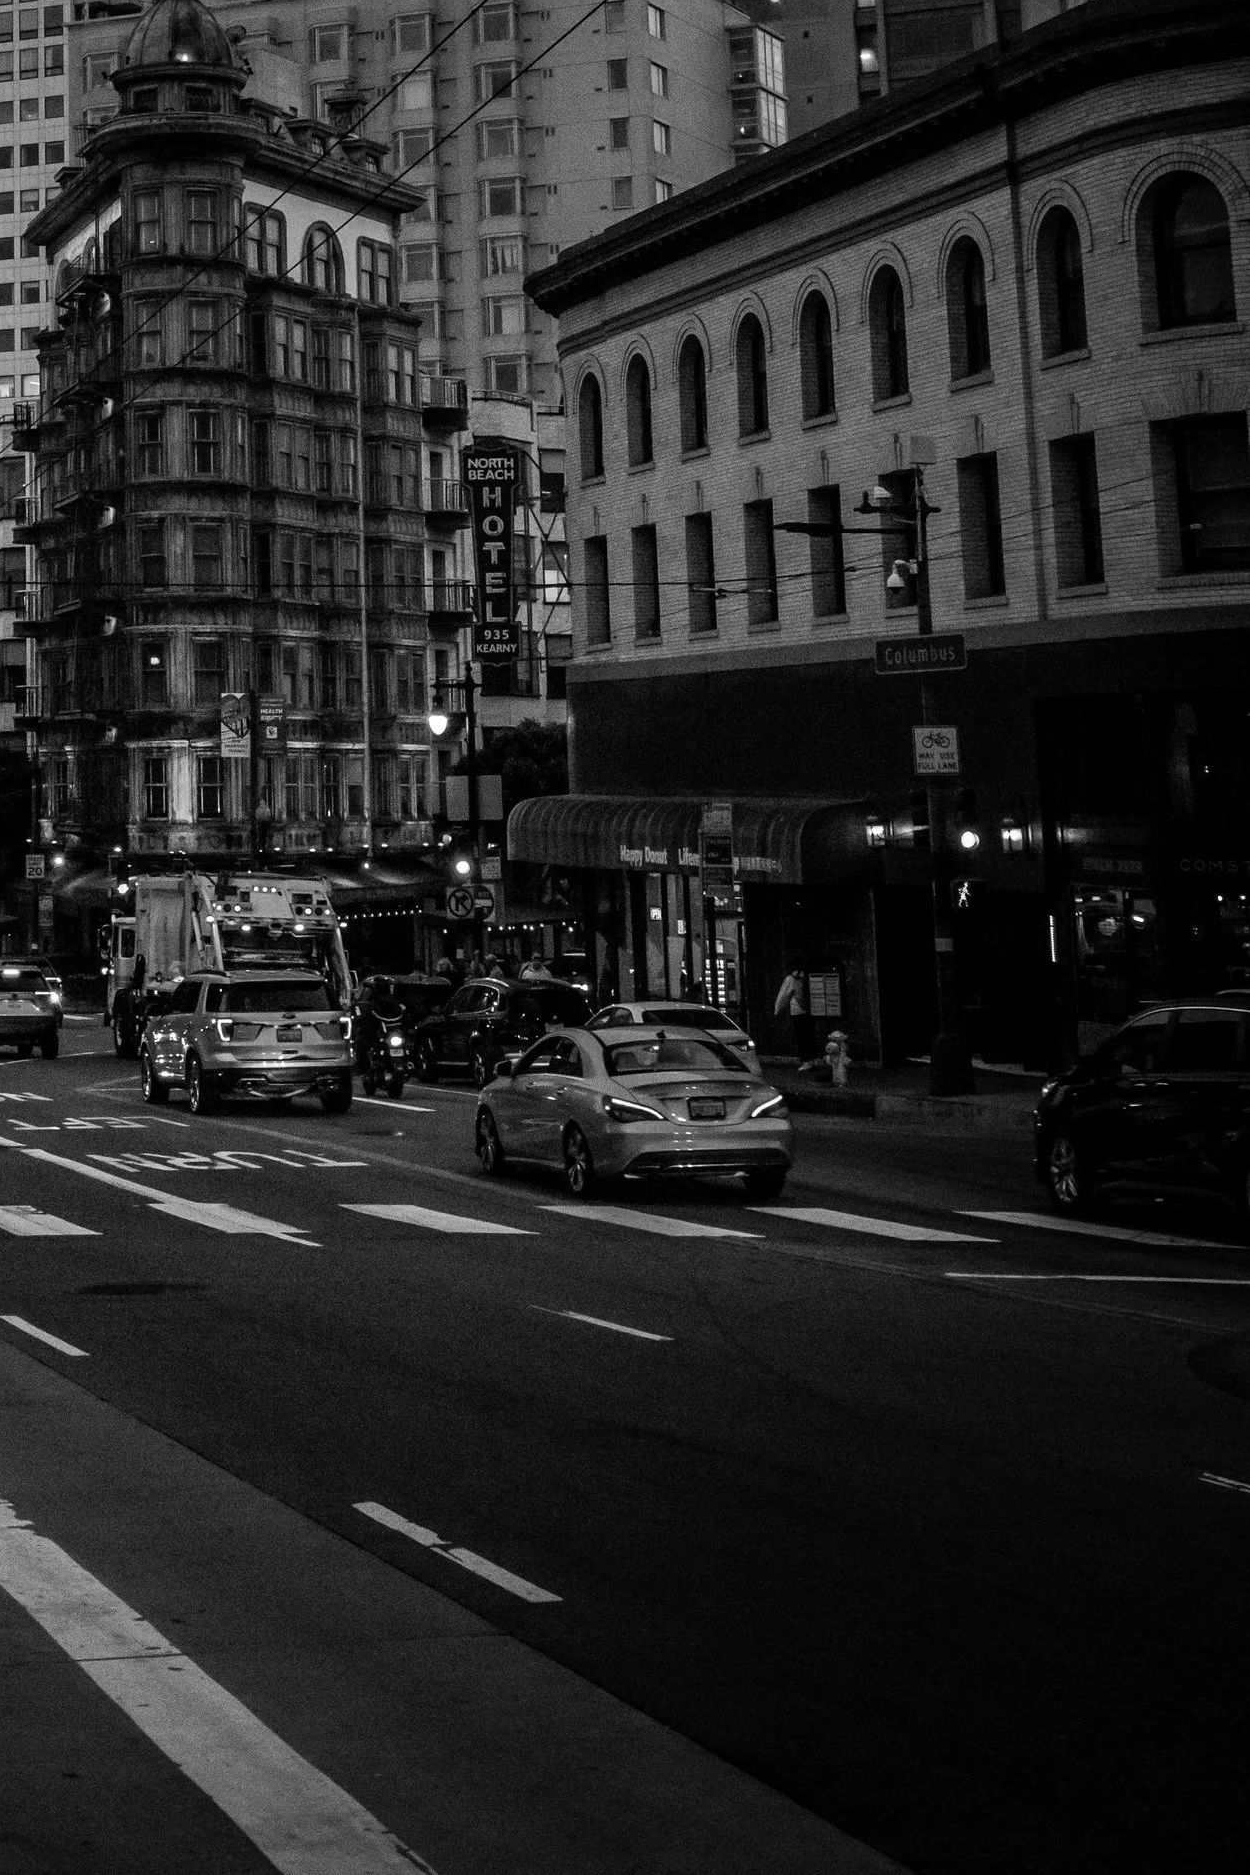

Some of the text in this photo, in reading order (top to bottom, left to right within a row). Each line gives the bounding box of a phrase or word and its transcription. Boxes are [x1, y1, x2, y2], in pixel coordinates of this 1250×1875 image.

[467, 457, 515, 470] NORTH
[468, 469, 515, 481] BEACH
[482, 486, 508, 623] HOTEL
[483, 629, 510, 641] 935
[476, 643, 518, 654] KEARNY
[885, 644, 956, 665] Columbus
[918, 752, 955, 760] MAY USE
[918, 762, 957, 770] FULL LANE
[620, 844, 643, 867] Happy
[28, 867, 43, 876] 20
[6, 1115, 190, 1130] LEFT
[86, 1149, 370, 1173] TURN
